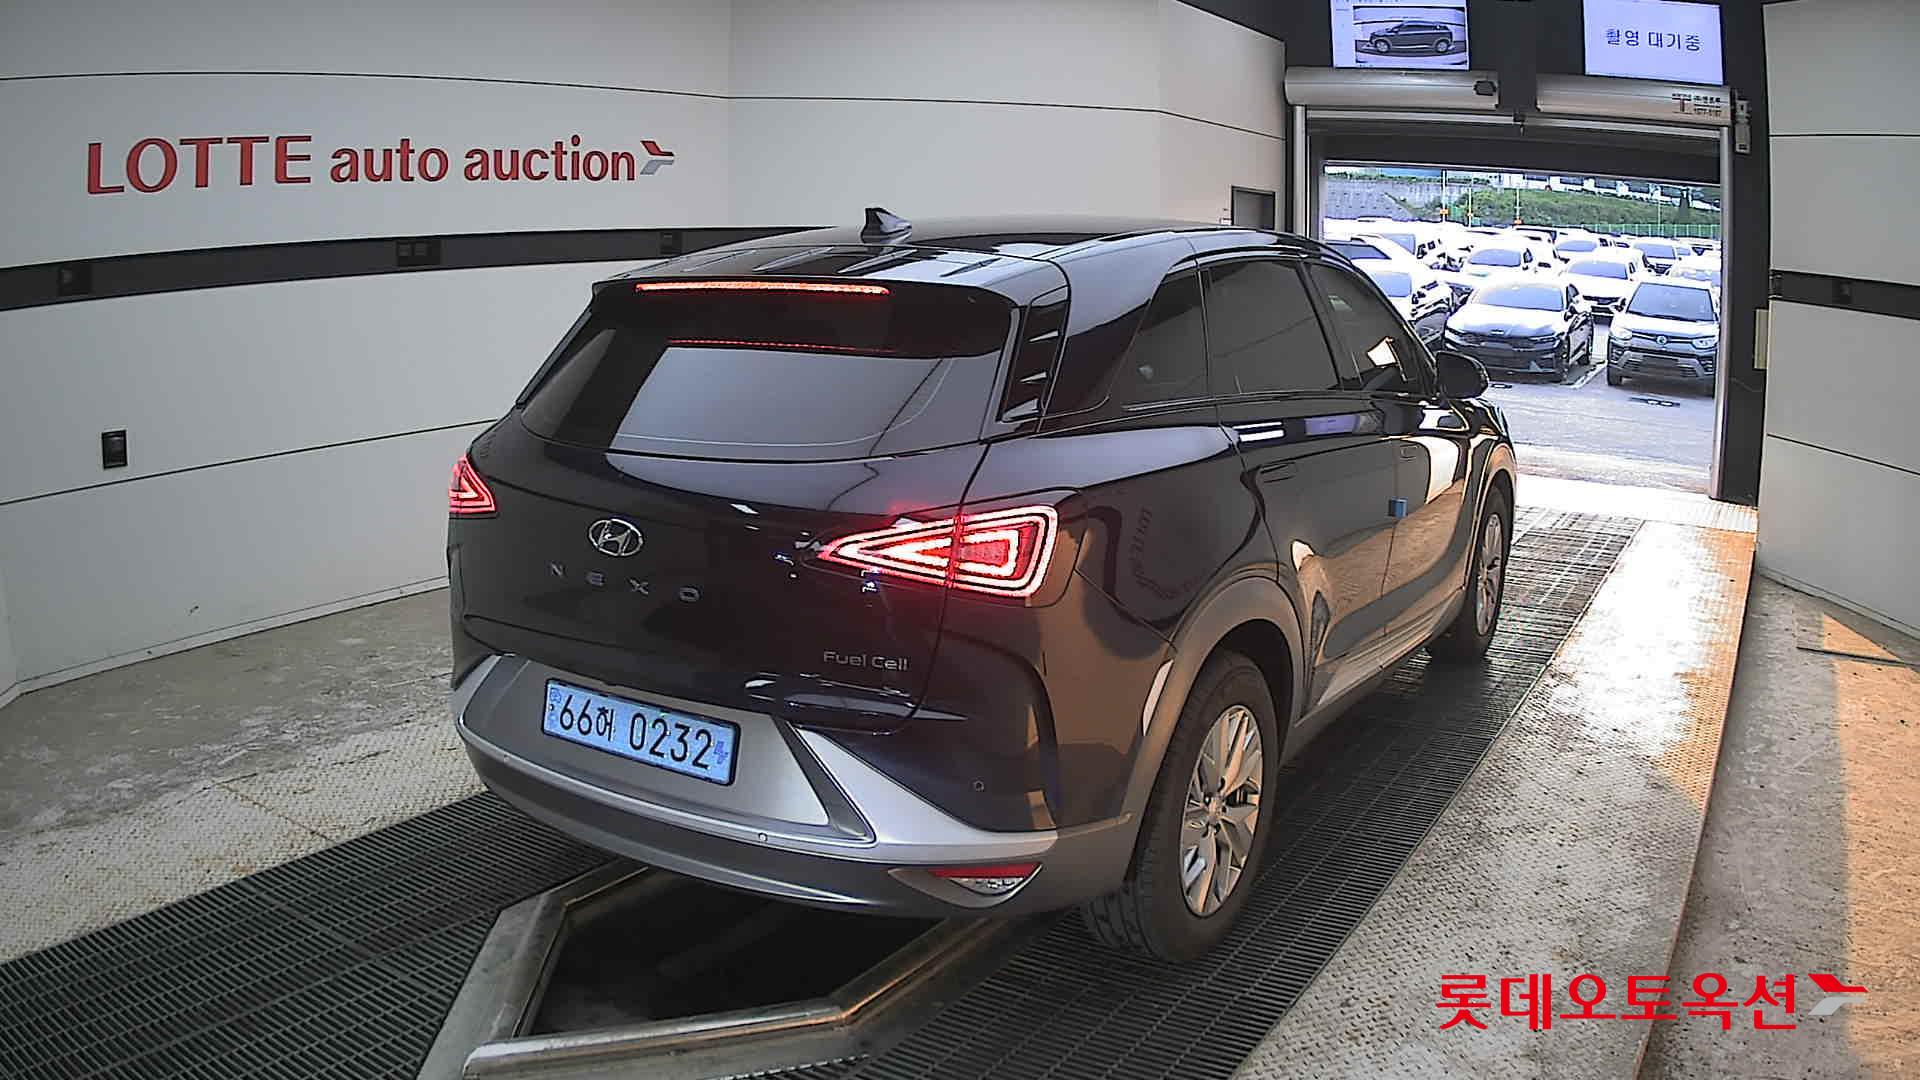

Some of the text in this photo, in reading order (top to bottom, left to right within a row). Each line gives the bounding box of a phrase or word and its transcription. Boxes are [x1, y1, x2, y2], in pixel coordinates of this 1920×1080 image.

[1648, 31, 1700, 52] 대기중
[87, 134, 636, 195] LOTTE auto auction
[550, 562, 699, 602] NEXO
[823, 650, 908, 671] Fuel Cell
[559, 694, 615, 742] 66허
[629, 712, 712, 769] 0232
